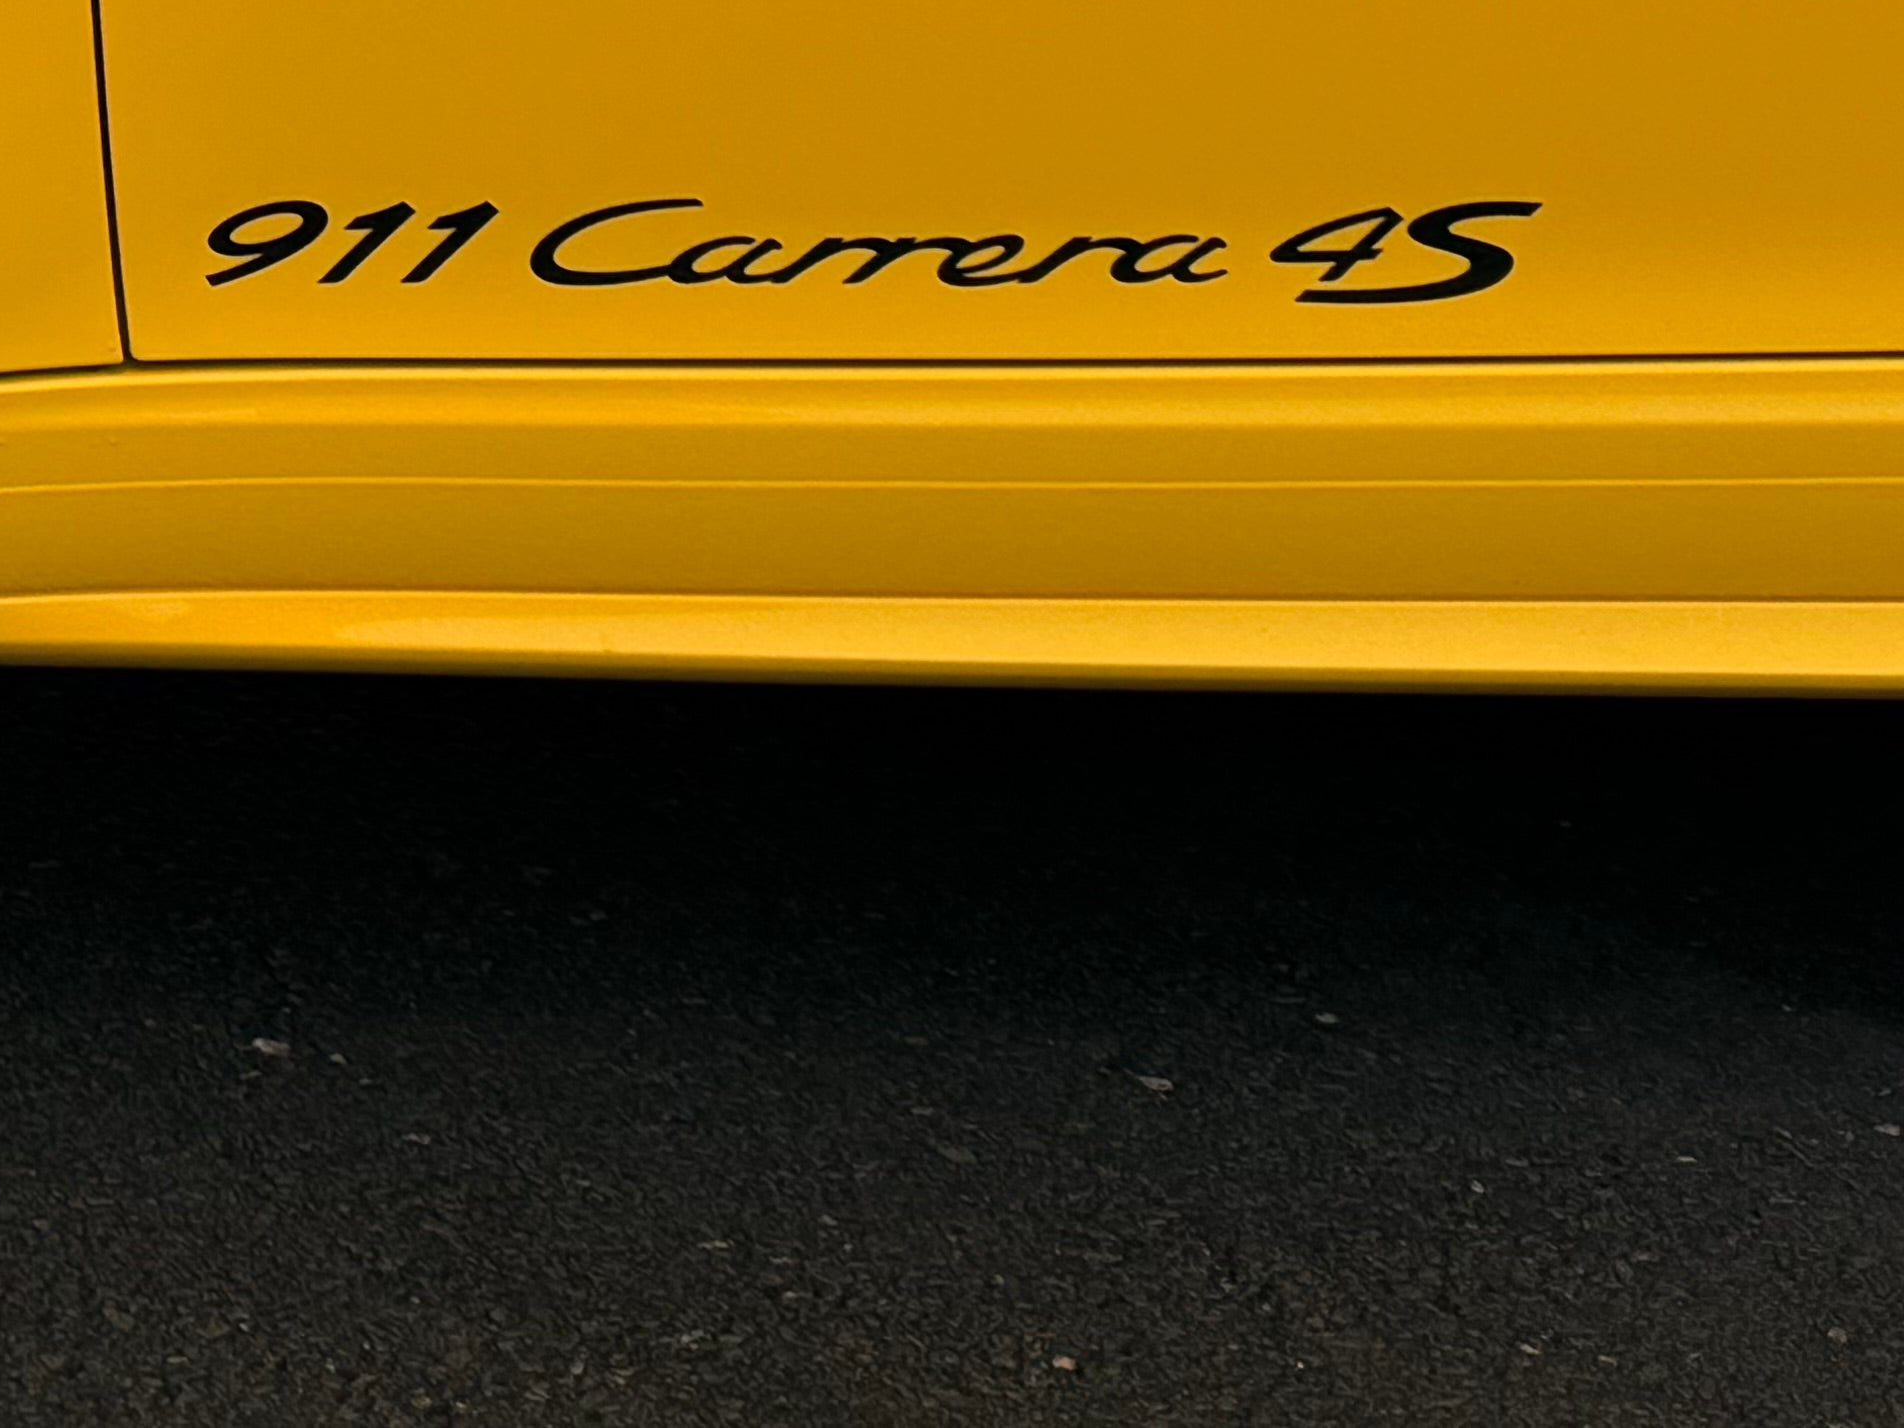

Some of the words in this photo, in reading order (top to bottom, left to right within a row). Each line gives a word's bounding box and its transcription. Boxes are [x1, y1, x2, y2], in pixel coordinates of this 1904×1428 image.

[205, 200, 499, 287] 911
[529, 198, 1228, 287] Carrera
[1269, 201, 1543, 304] 4S
